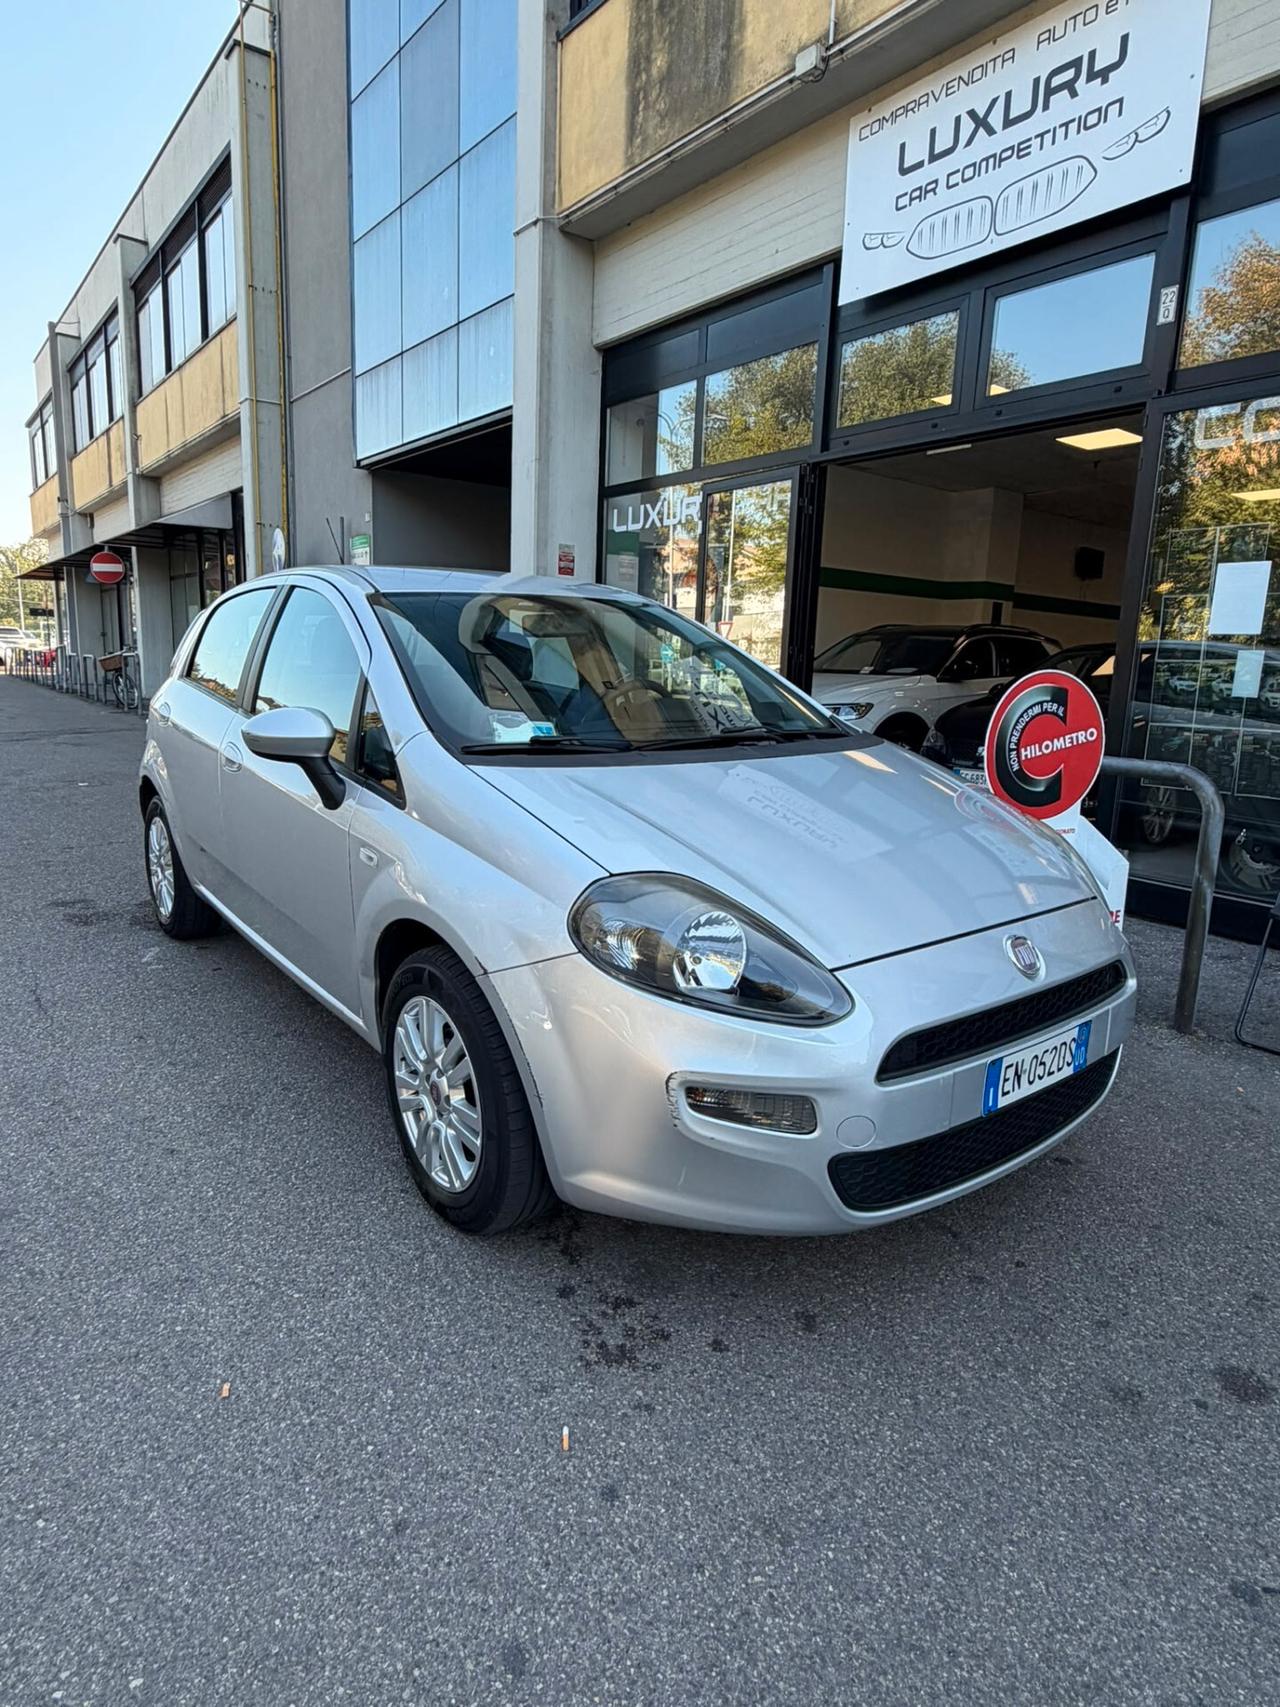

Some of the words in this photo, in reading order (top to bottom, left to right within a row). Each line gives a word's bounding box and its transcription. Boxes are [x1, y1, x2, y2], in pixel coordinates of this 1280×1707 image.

[858, 47, 1016, 142] COMPRAVENDITA
[1036, 3, 1099, 51] AUTO
[897, 31, 1130, 177] LUXURY
[895, 178, 940, 212] CAR
[945, 96, 1125, 190] COMPETITION
[1162, 290, 1176, 305] 22
[613, 491, 703, 534] LUXUR
[1009, 704, 1042, 749] PRENDERMI
[1042, 702, 1058, 713] PER
[1058, 705, 1065, 717] IL
[1009, 750, 1020, 772] NON
